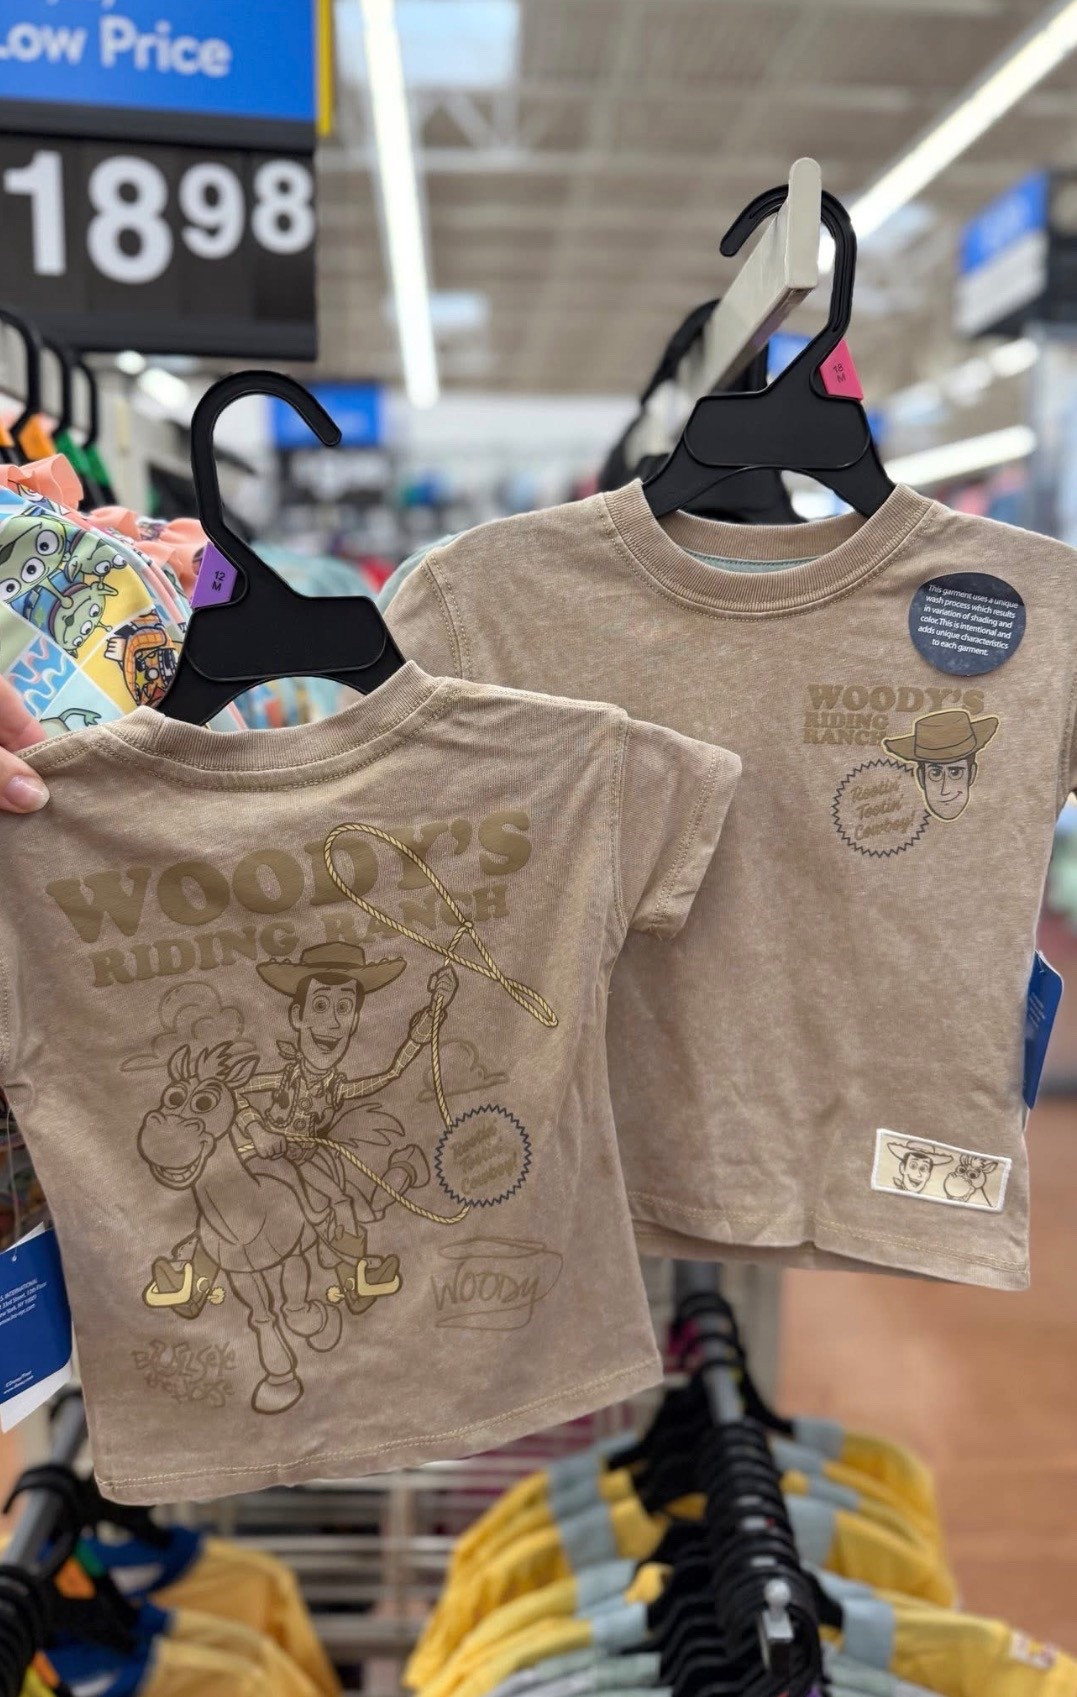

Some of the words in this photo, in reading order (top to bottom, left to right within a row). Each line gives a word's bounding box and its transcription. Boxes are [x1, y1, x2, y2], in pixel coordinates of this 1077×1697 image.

[99, 14, 233, 79] Price
[833, 363, 844, 373] 18
[837, 372, 847, 383] M
[211, 580, 222, 592] M
[215, 570, 226, 582] 12
[926, 595, 944, 604] wash
[944, 598, 971, 611] process
[971, 603, 993, 614] which
[993, 608, 1016, 619] results
[928, 584, 942, 594] This
[942, 588, 972, 600] garment
[972, 593, 988, 603] uses
[994, 598, 1019, 609] unique
[923, 604, 931, 613] in
[932, 607, 962, 618] variation
[962, 612, 971, 620] of
[970, 613, 998, 628] shading
[998, 620, 1013, 629] and
[918, 625, 935, 635] adds
[935, 629, 960, 640] unique
[960, 633, 1009, 650] characteristics
[953, 621, 960, 629] is
[960, 621, 998, 637] intentional
[997, 631, 1012, 640] and
[932, 638, 940, 646] to
[940, 641, 957, 650] each
[806, 684, 985, 714] WOODY'S
[803, 711, 889, 730] RIDING
[803, 729, 887, 746] RANCH
[46, 810, 531, 944] WOODY'S
[322, 883, 509, 943] RANCH
[88, 920, 298, 987] RIDING
